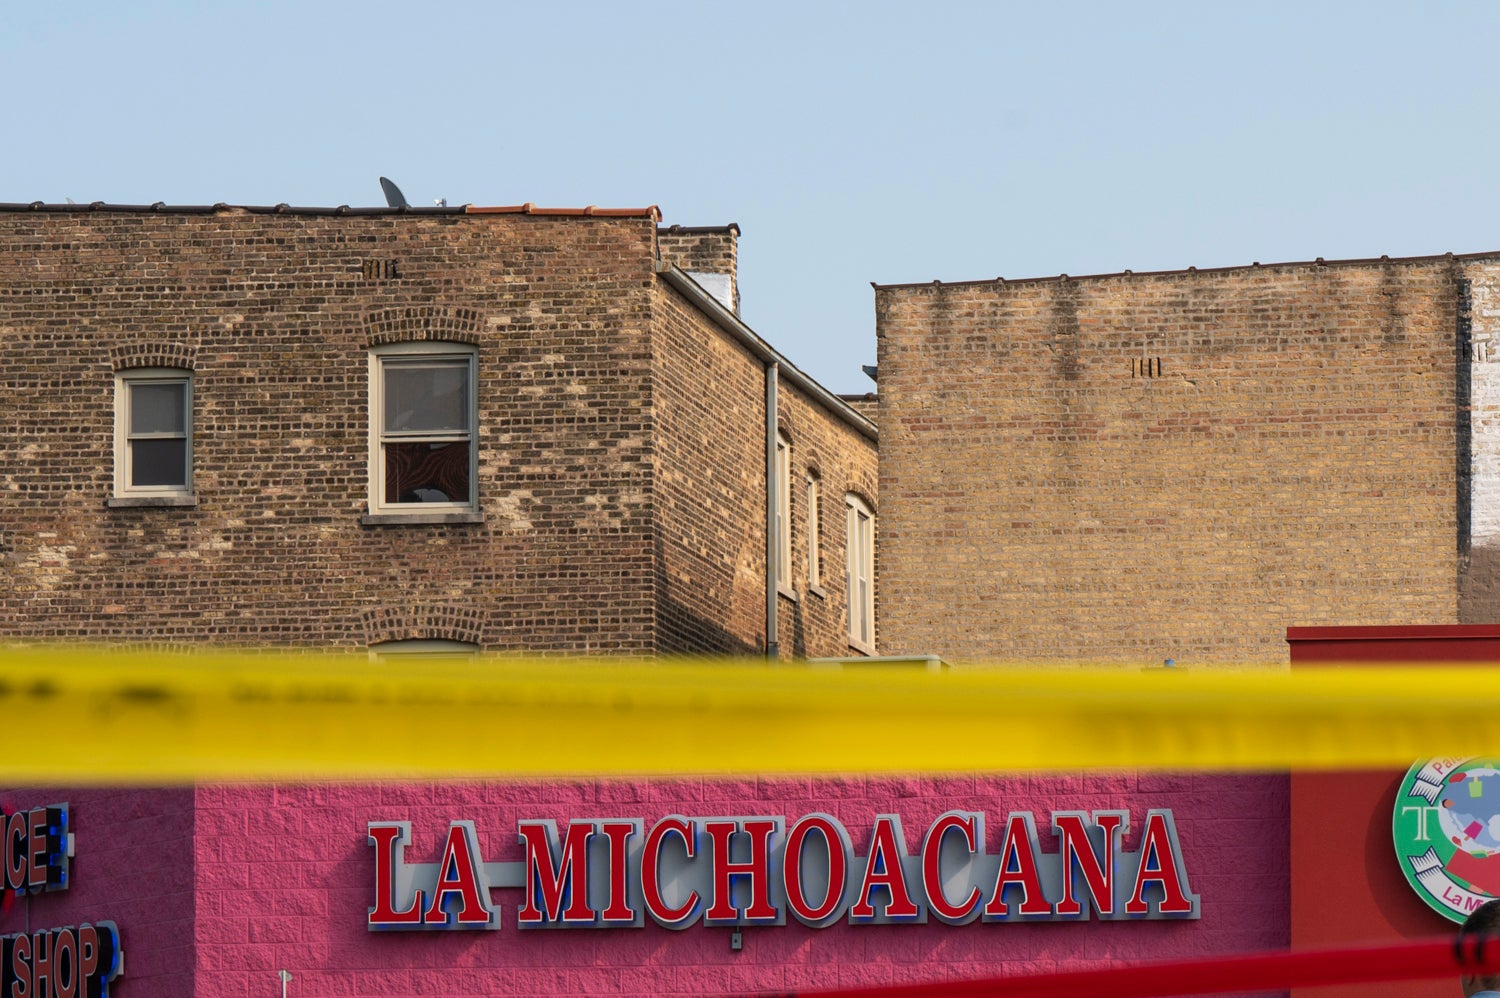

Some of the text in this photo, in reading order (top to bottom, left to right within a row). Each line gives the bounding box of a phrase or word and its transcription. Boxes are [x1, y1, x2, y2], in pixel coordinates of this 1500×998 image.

[1401, 805, 1440, 841] T
[367, 813, 1192, 925] LA MICHOACANA
[1442, 885, 1463, 907] La
